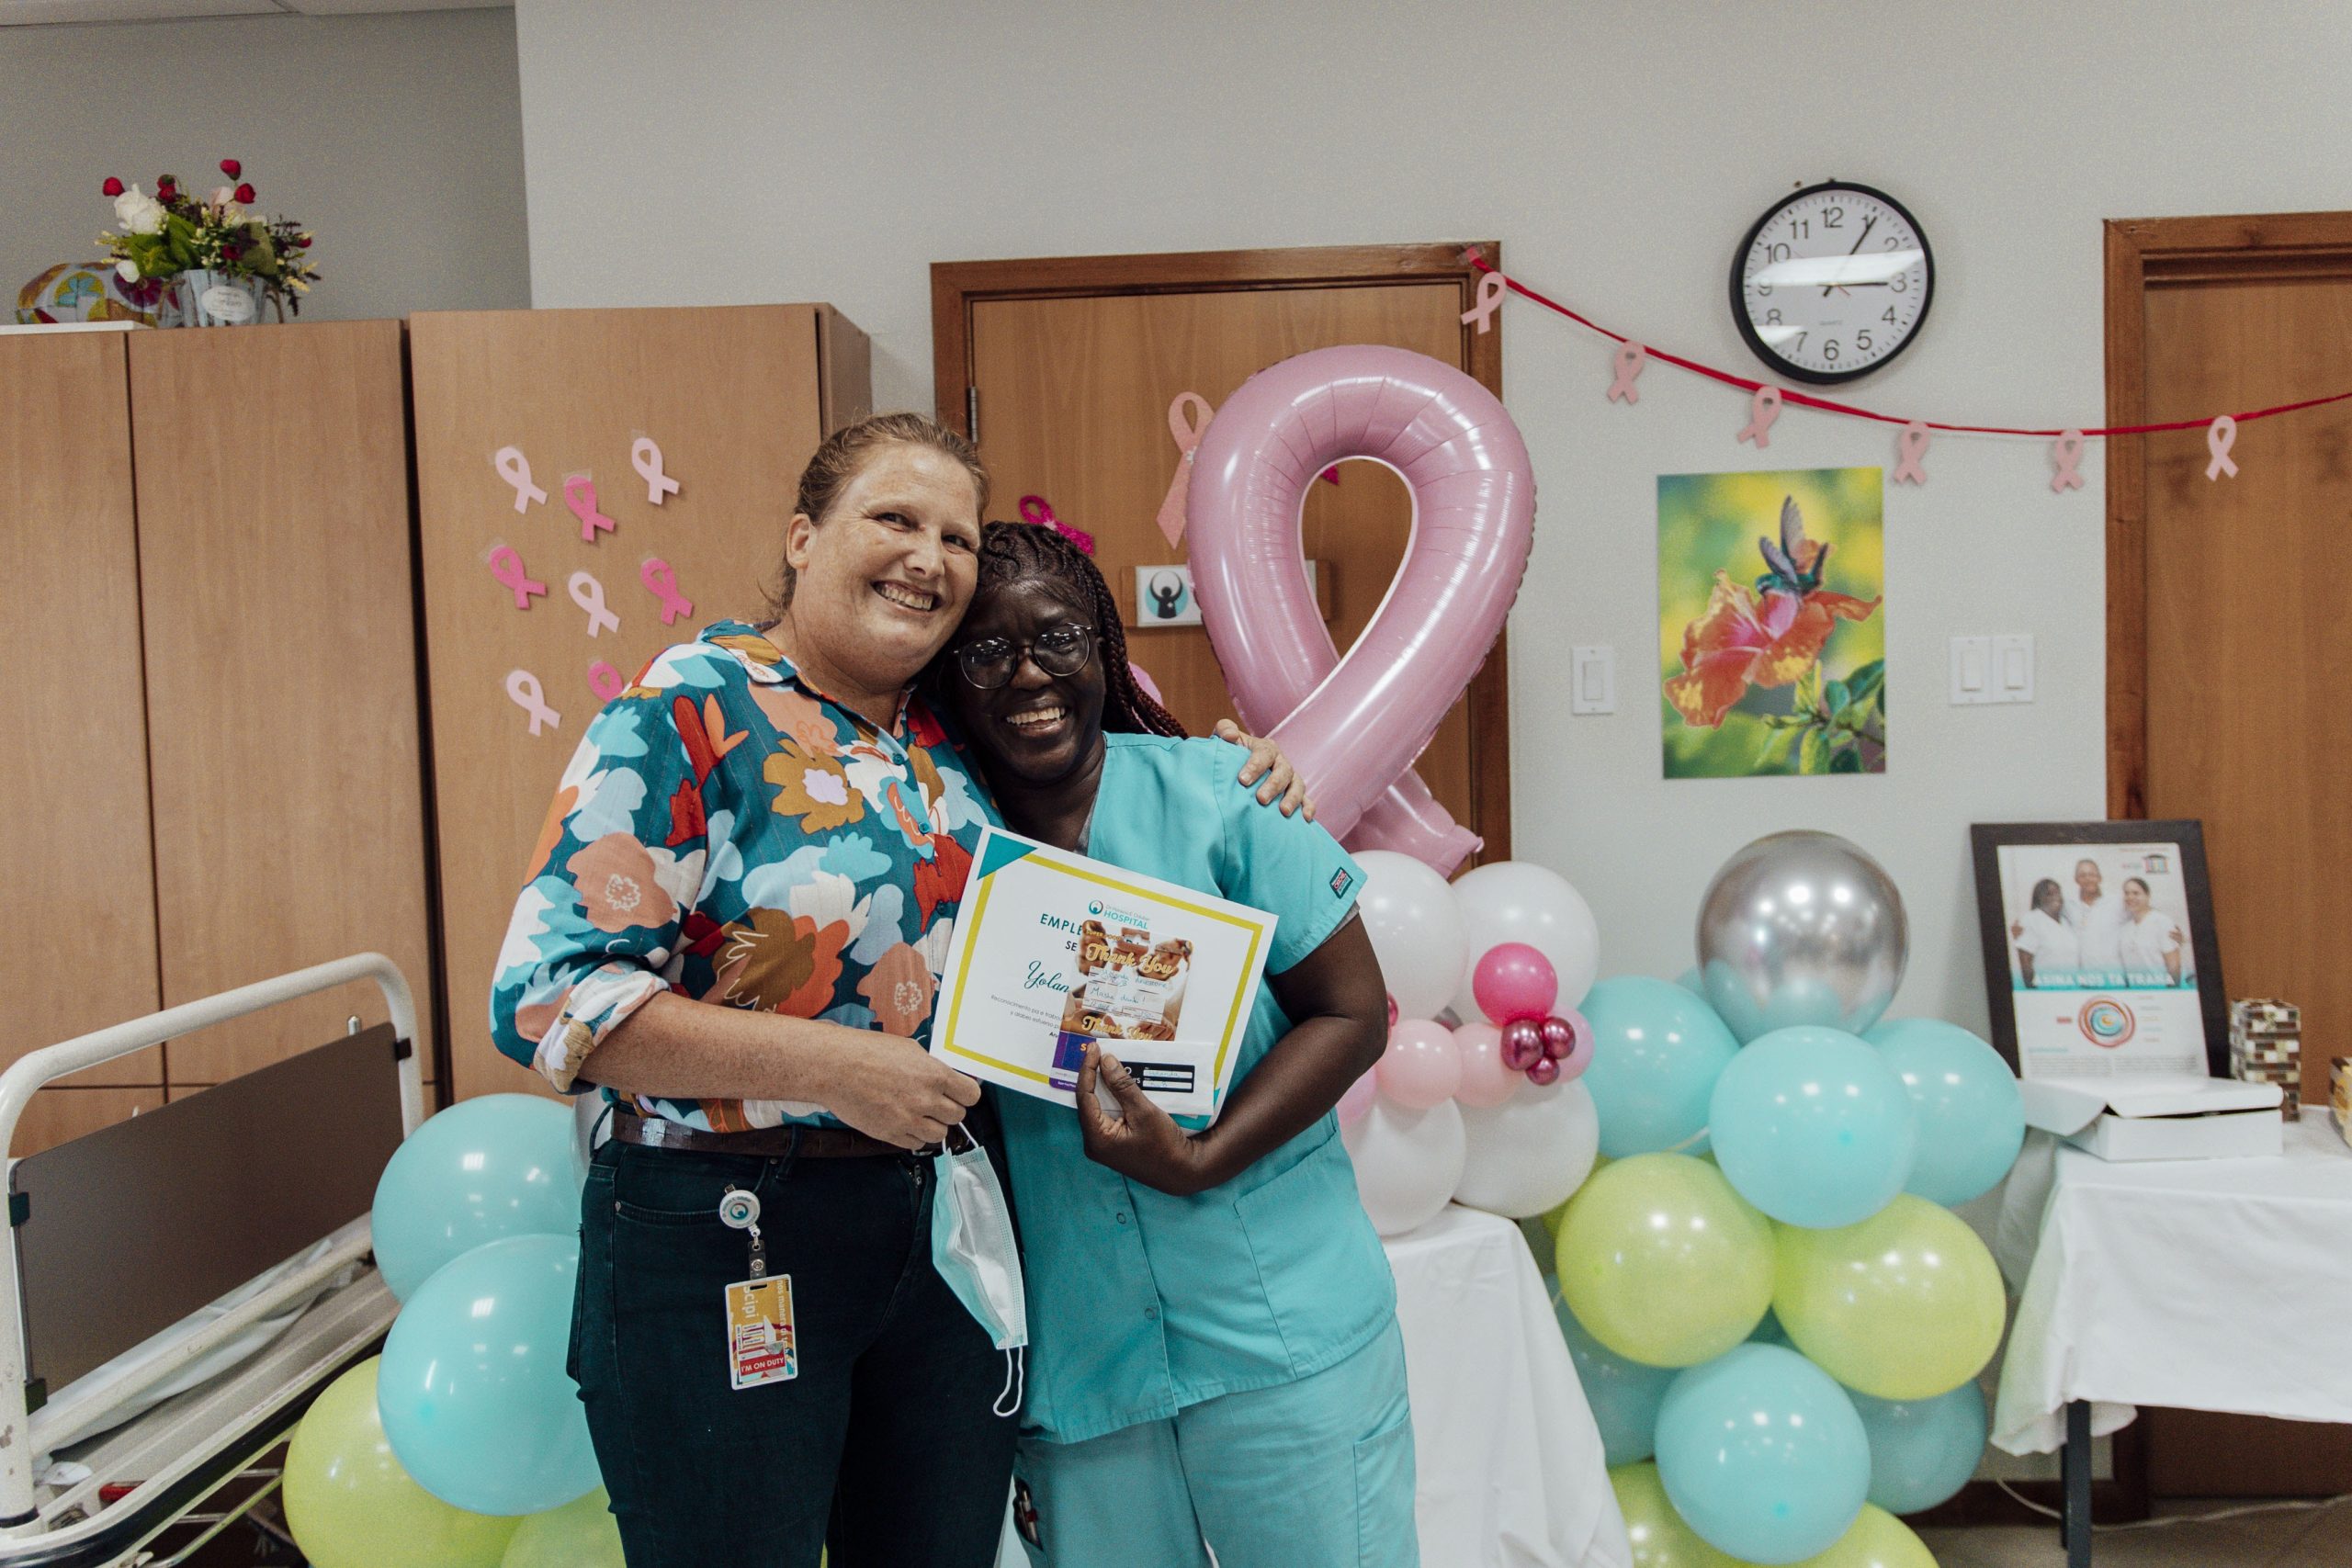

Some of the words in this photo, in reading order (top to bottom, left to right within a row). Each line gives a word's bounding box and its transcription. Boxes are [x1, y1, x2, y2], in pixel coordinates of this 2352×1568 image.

[1821, 207, 1844, 229] 12
[1789, 220, 1809, 240] 11
[1764, 243, 1791, 265] 10
[1884, 237, 1899, 254] 2
[1890, 272, 1907, 293] 3
[1766, 309, 1782, 327] 8
[1882, 306, 1897, 325] 4
[1796, 332, 1808, 353] 7
[1824, 339, 1840, 361] 6
[1856, 329, 1872, 351] 5
[1103, 909, 1148, 930] HOSPITAL
[1065, 940, 1079, 952] SE
[1085, 942, 1137, 966] Thank
[1138, 954, 1178, 974] You
[1023, 960, 1069, 993] Yolan
[1081, 1015, 1124, 1036] Thank
[1126, 1025, 1155, 1041] You
[741, 1364, 752, 1373] I'M
[753, 1360, 765, 1370] ON
[766, 1357, 785, 1367] DUTY
